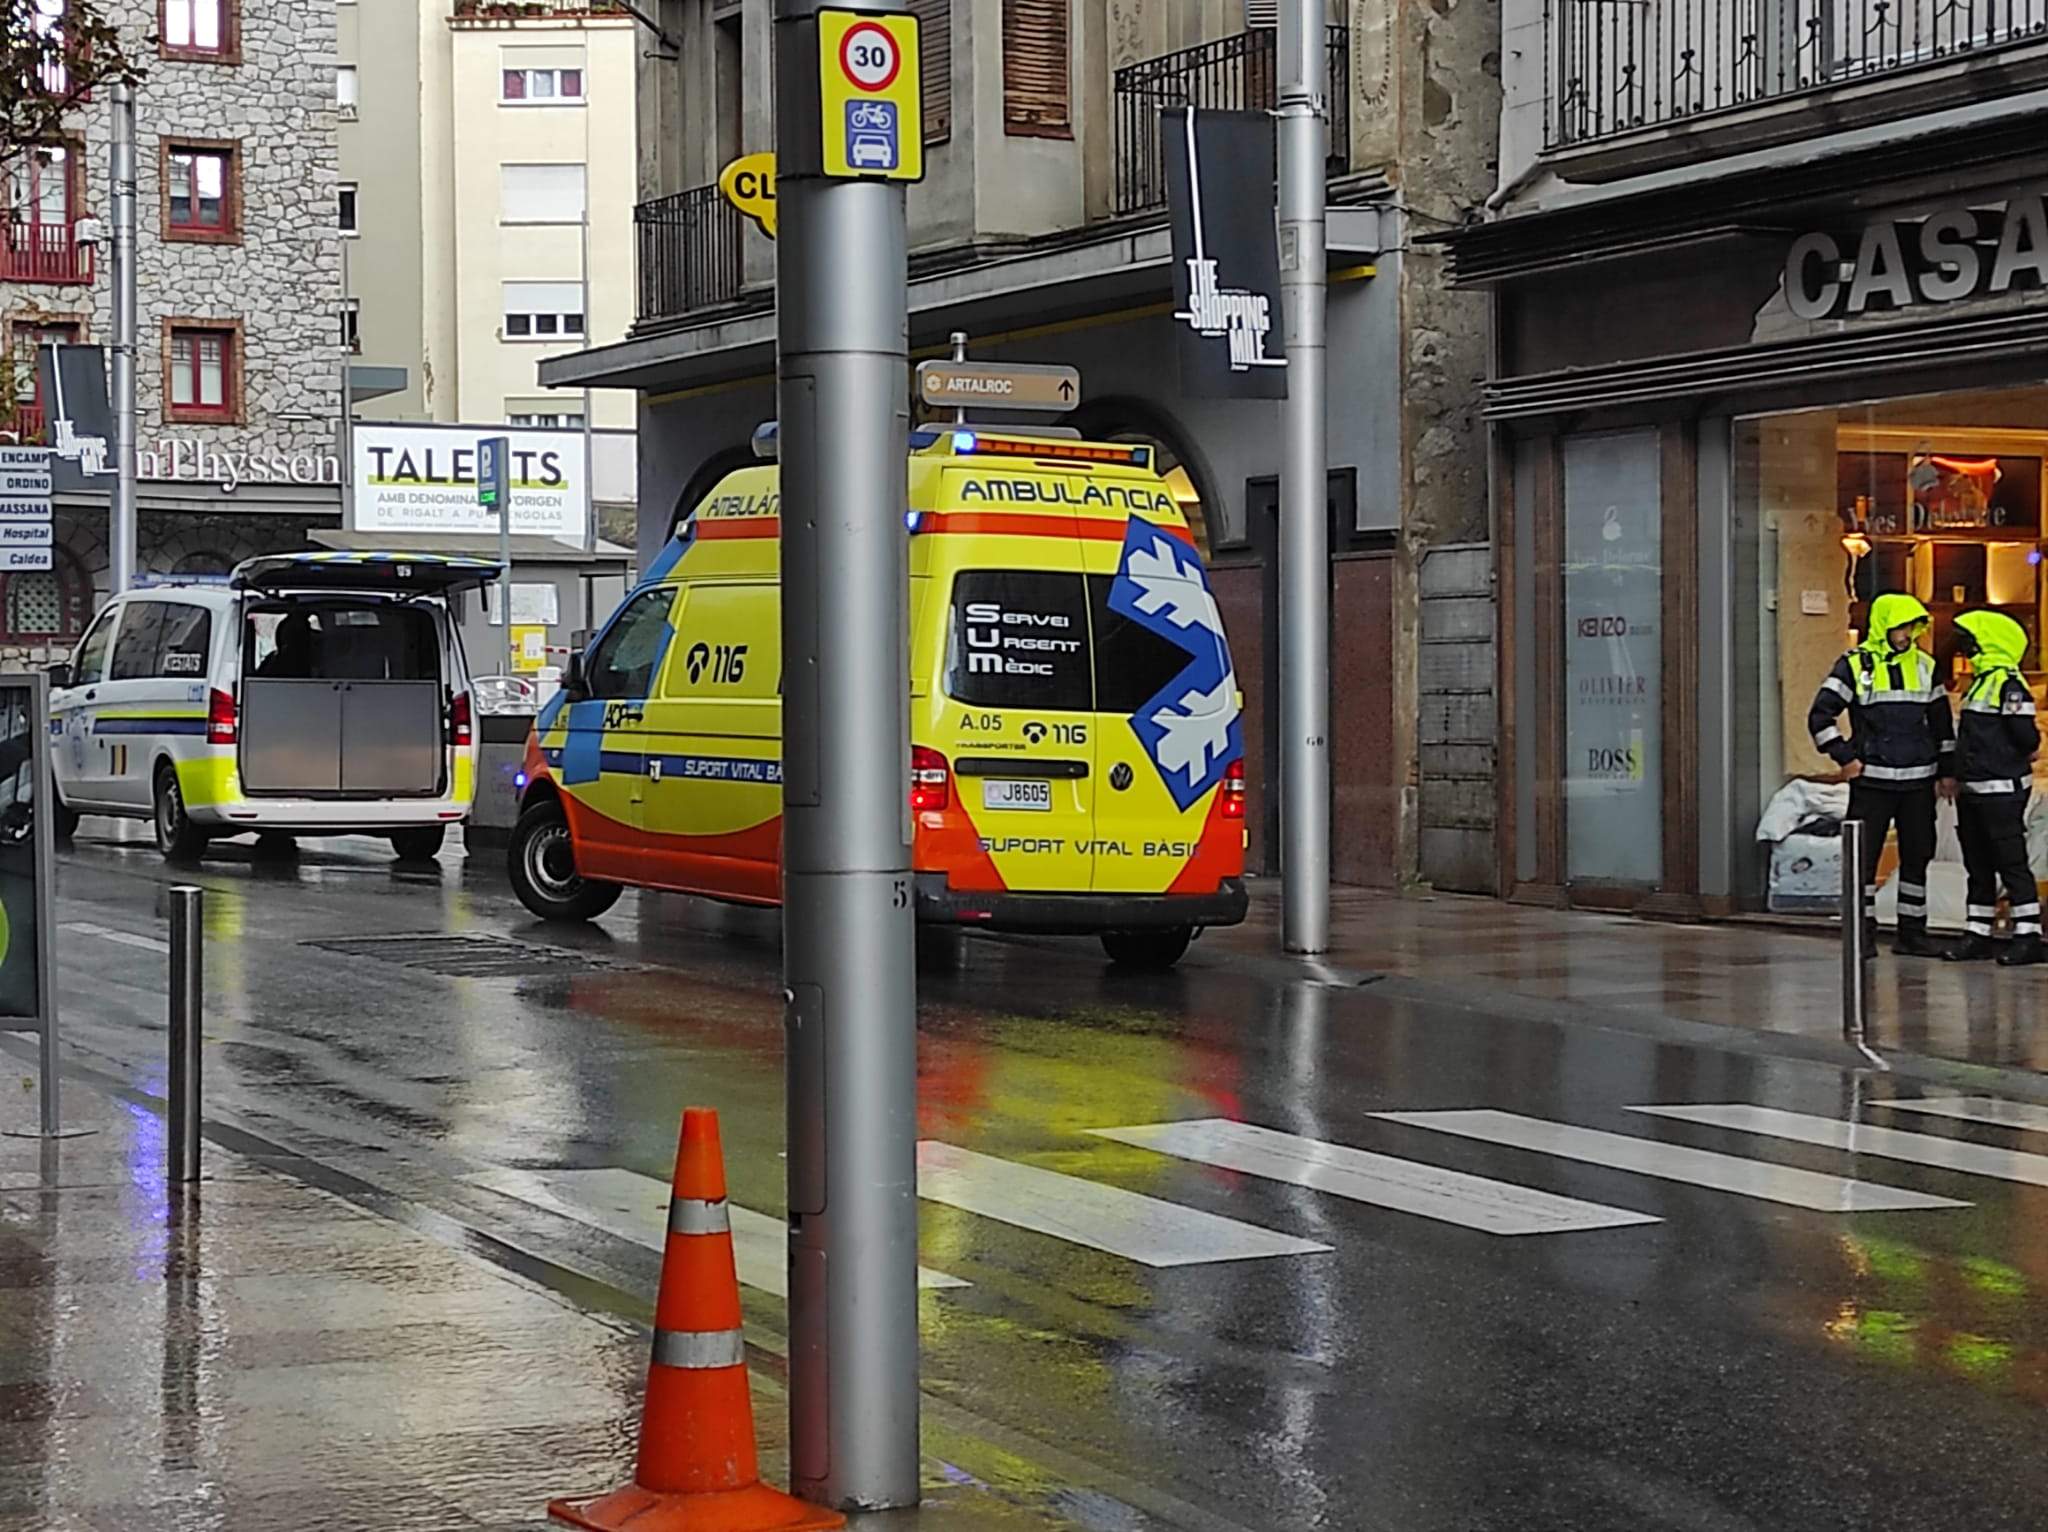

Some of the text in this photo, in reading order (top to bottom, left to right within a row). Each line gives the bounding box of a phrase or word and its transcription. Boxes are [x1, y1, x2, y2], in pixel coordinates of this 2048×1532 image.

[855, 46, 885, 67] 30
[734, 172, 776, 200] CL
[1784, 192, 2048, 320] CASA
[1189, 293, 1270, 331] SHOPPING
[946, 377, 1013, 394] ARTALROC
[1, 452, 49, 464] ENCAMP
[136, 438, 341, 492] nThyssen
[367, 446, 562, 486] TALETS
[7, 478, 49, 489] ORDINO
[377, 493, 406, 504] AMB
[408, 493, 478, 505] DENOMINA
[706, 486, 779, 517] AMBULÀN
[961, 476, 1176, 515] AMBULÀNCIA
[377, 507, 393, 518] DE
[3, 527, 49, 539] Hospital
[10, 553, 48, 565] Caldea
[712, 645, 748, 684] 116
[960, 713, 1002, 731] A.05
[1053, 724, 1087, 745] 116
[684, 759, 783, 781] SUPORT VITAL BÀ
[1588, 748, 1637, 772] BOSS
[1003, 783, 1048, 802] J8605
[979, 837, 1065, 855] SUPORT
[1074, 840, 1133, 856] VITAL
[893, 880, 907, 908] 5
